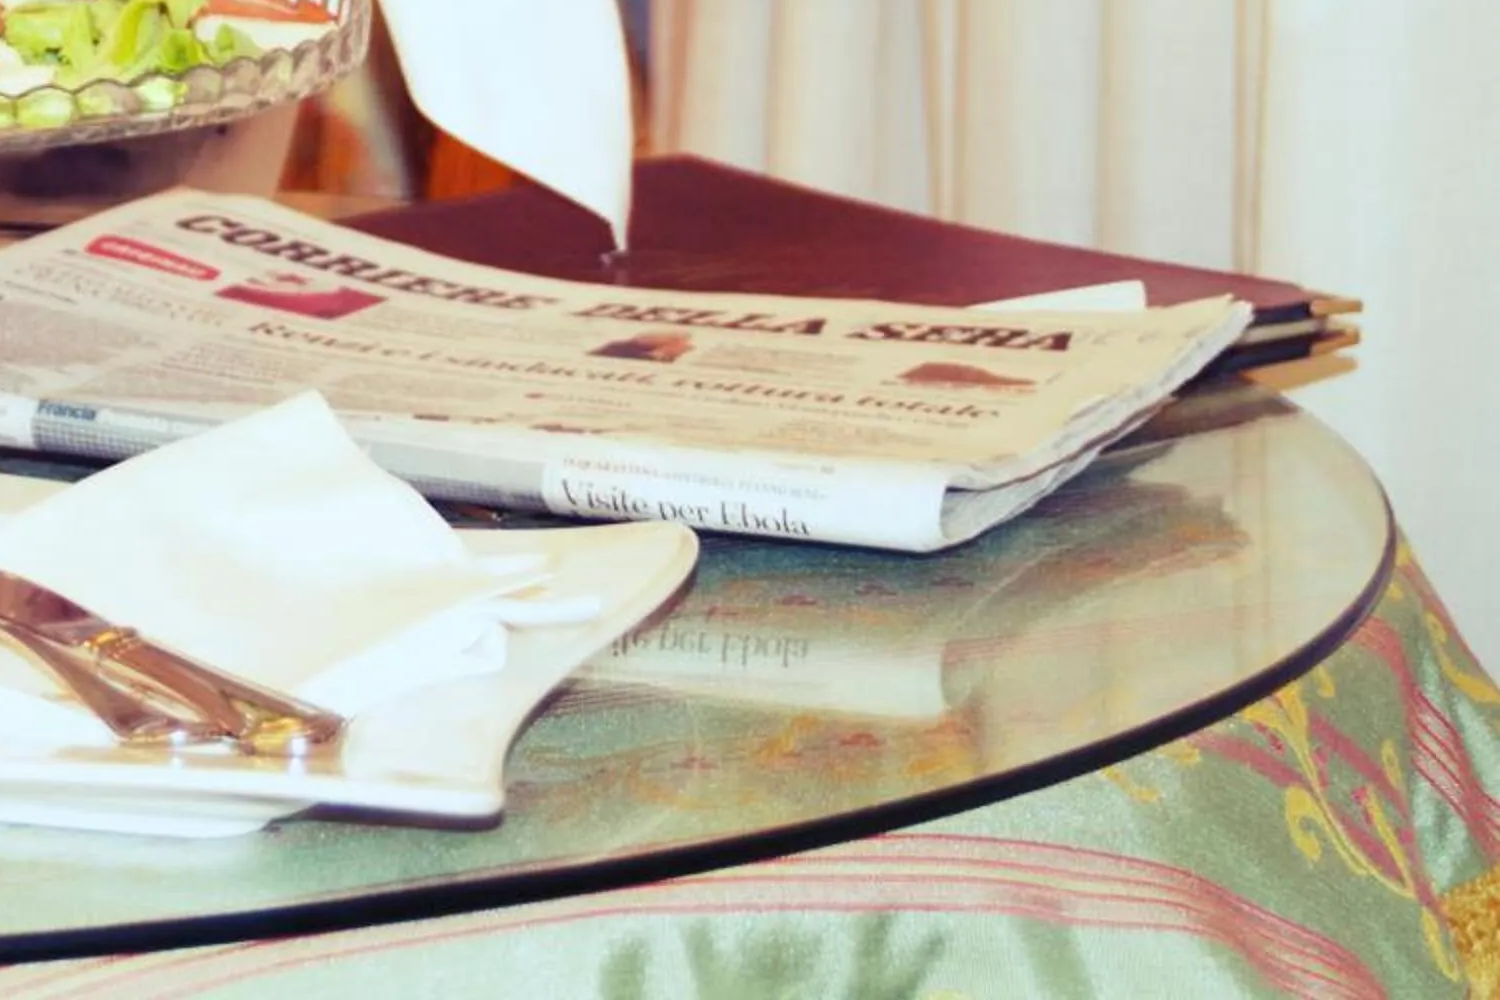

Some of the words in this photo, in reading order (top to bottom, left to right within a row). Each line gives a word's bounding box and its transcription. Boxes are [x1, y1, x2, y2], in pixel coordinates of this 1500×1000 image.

[175, 214, 558, 310] CORRIERE
[571, 302, 828, 336] DELLA
[844, 321, 1076, 352] SERA
[561, 478, 648, 513] Visite
[658, 500, 709, 523] per
[720, 500, 810, 536] Ebola
